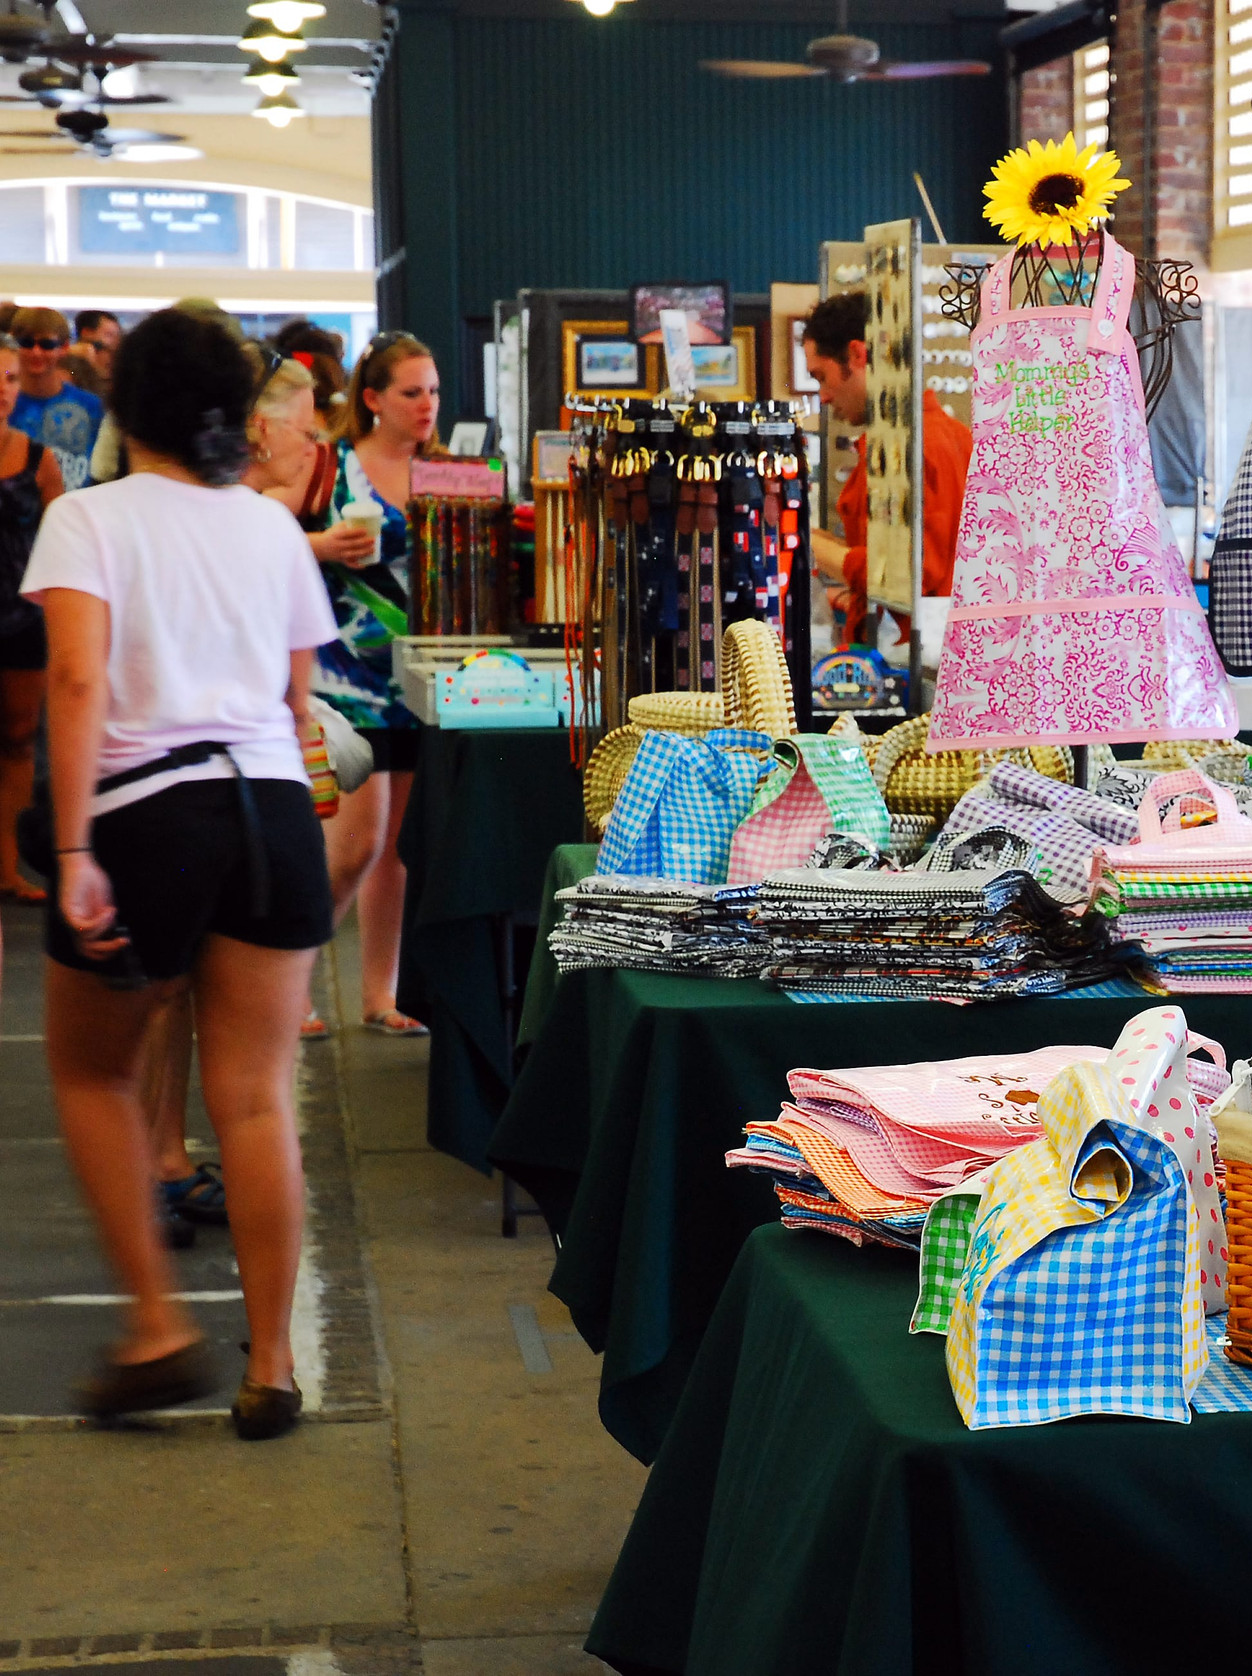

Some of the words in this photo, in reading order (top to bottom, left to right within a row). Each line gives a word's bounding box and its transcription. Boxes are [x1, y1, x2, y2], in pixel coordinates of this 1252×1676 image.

[995, 360, 1089, 387] Mommy's
[1014, 385, 1067, 407] Little
[1008, 409, 1074, 439] Helper
